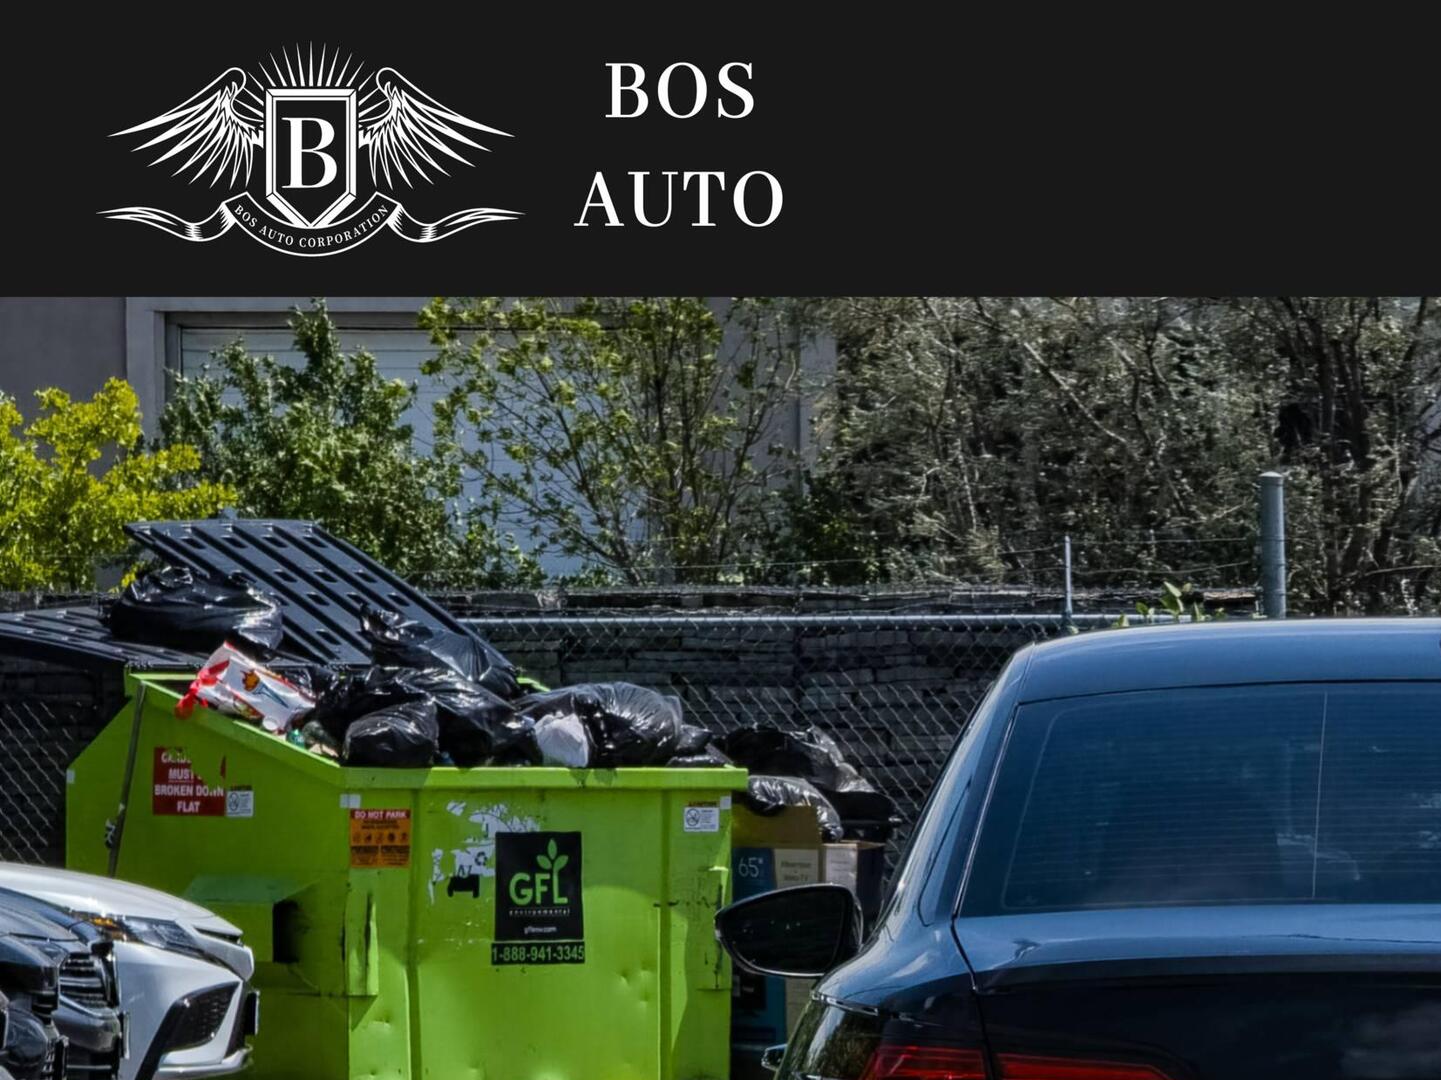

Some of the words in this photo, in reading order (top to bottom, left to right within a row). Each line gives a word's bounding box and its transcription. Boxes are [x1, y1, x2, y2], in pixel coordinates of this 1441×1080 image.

[154, 784, 194, 797] BROKEN
[177, 801, 200, 813] FLAT
[367, 810, 384, 819] NOT
[385, 810, 407, 819] PARK
[509, 867, 569, 906] GFL
[492, 945, 585, 961] 1-888-941-3345
